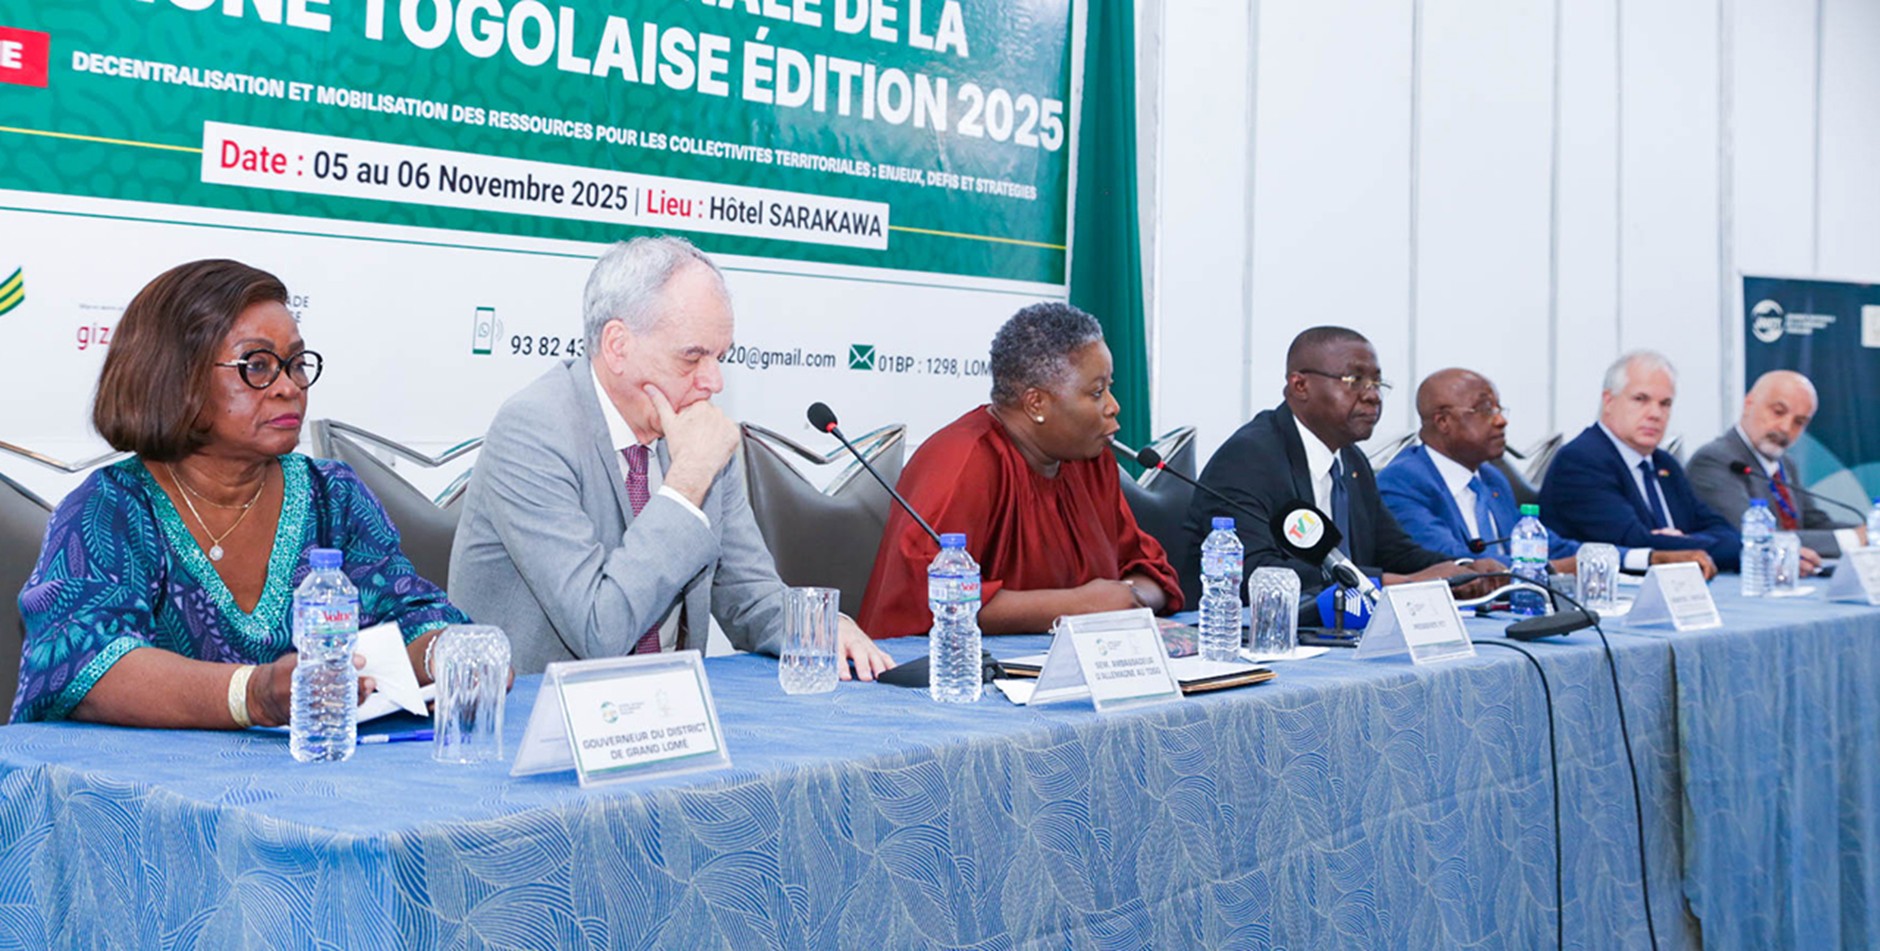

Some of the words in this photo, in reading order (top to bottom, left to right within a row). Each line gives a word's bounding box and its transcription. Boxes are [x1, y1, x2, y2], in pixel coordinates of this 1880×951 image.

[908, 0, 969, 58] LA
[742, 26, 948, 132] ÉDITION
[957, 82, 1064, 152] 2025
[72, 50, 284, 99] DECENTRALISATION
[288, 82, 314, 101] ET
[317, 86, 449, 120] MOBILISATION
[451, 106, 486, 126] DES
[488, 110, 594, 141] RESSOURCES
[596, 125, 638, 147] POUR
[640, 132, 668, 151] LES
[670, 136, 773, 165] COLLECTIVITES
[775, 150, 871, 178] TERRITORIALES
[878, 164, 925, 188] ENJEUX,
[927, 171, 960, 190] DEFIS
[961, 175, 976, 192] ET
[976, 178, 1038, 200] STRATEGIES
[220, 139, 288, 176] Date
[297, 154, 304, 177] :
[314, 151, 349, 181] 05
[357, 162, 390, 186] au
[397, 160, 431, 190] 06
[438, 164, 565, 204] Novembre
[571, 180, 628, 211] 2025
[646, 189, 692, 218] Lieu
[709, 195, 764, 225] Hôtel
[769, 203, 882, 238] SARAKAWA
[76, 322, 112, 351] giz
[510, 335, 534, 355] 93
[538, 336, 560, 356] 82
[878, 354, 915, 373] 01BP
[927, 358, 960, 378] 1298,
[582, 734, 650, 749] GOUVERNEUR
[650, 730, 666, 741] DU
[667, 722, 707, 736] DISTRICT
[610, 749, 624, 761] DE
[626, 743, 661, 758] GRAND
[663, 738, 689, 751] LOMÉ
